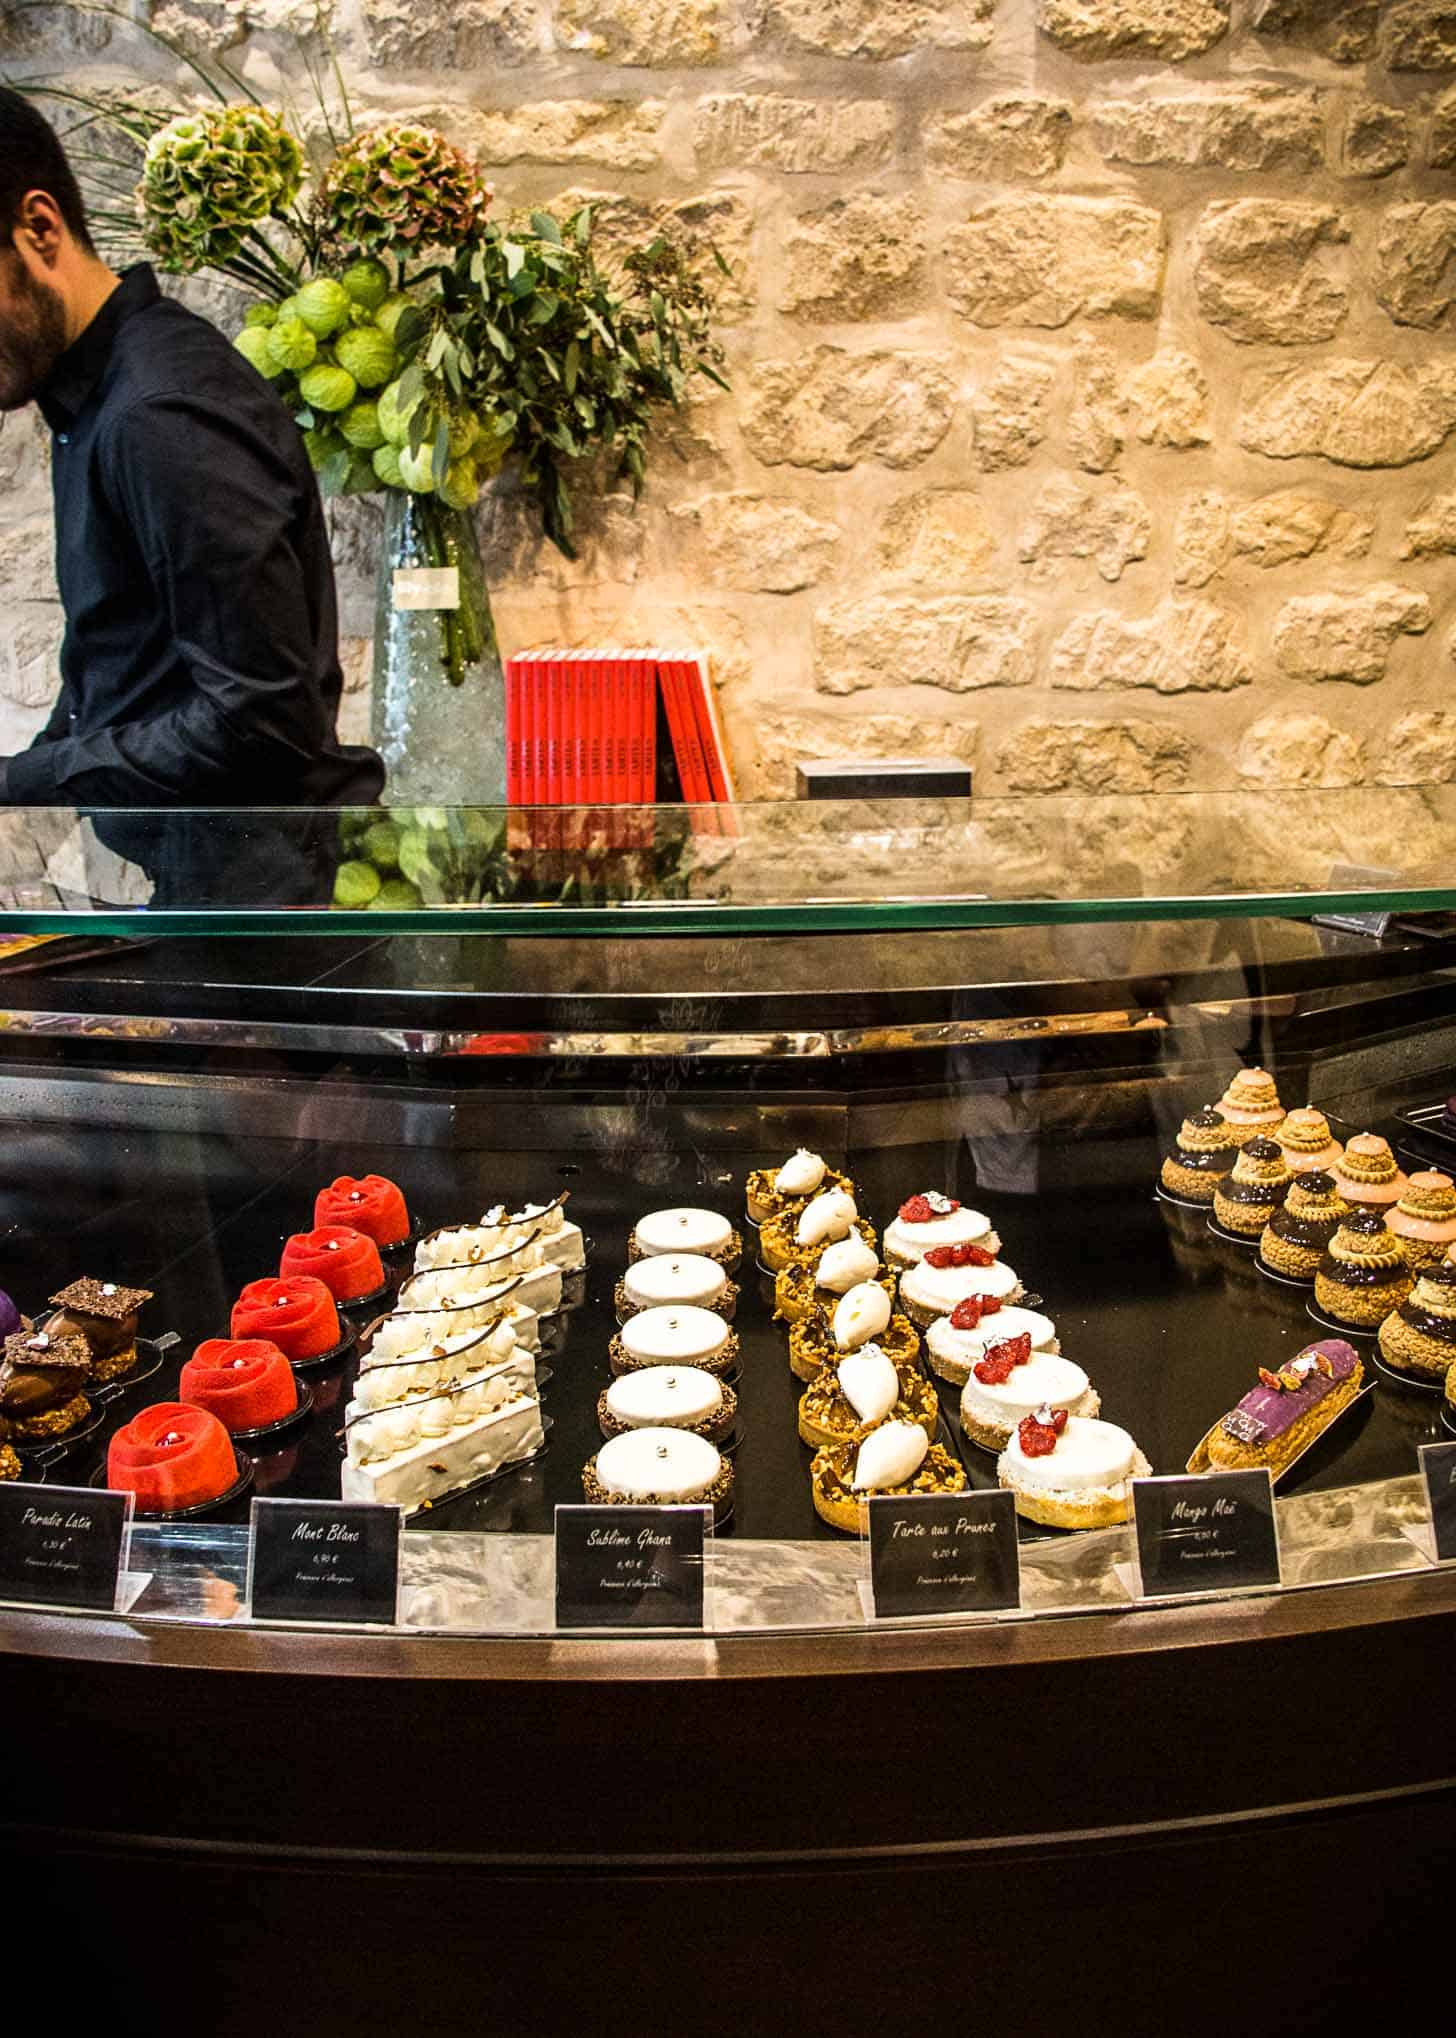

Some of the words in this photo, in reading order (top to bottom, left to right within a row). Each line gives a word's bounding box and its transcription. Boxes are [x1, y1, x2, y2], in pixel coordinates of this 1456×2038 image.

[65, 1512, 93, 1531] Latin
[1171, 1501, 1207, 1523] Mango
[291, 1522, 323, 1541] Mont
[326, 1523, 360, 1542] Blanc
[586, 1528, 631, 1547] Sublime
[636, 1528, 672, 1550] Ghana
[892, 1520, 926, 1539] Tarte
[931, 1525, 949, 1536] aux
[955, 1517, 997, 1536] Prunes
